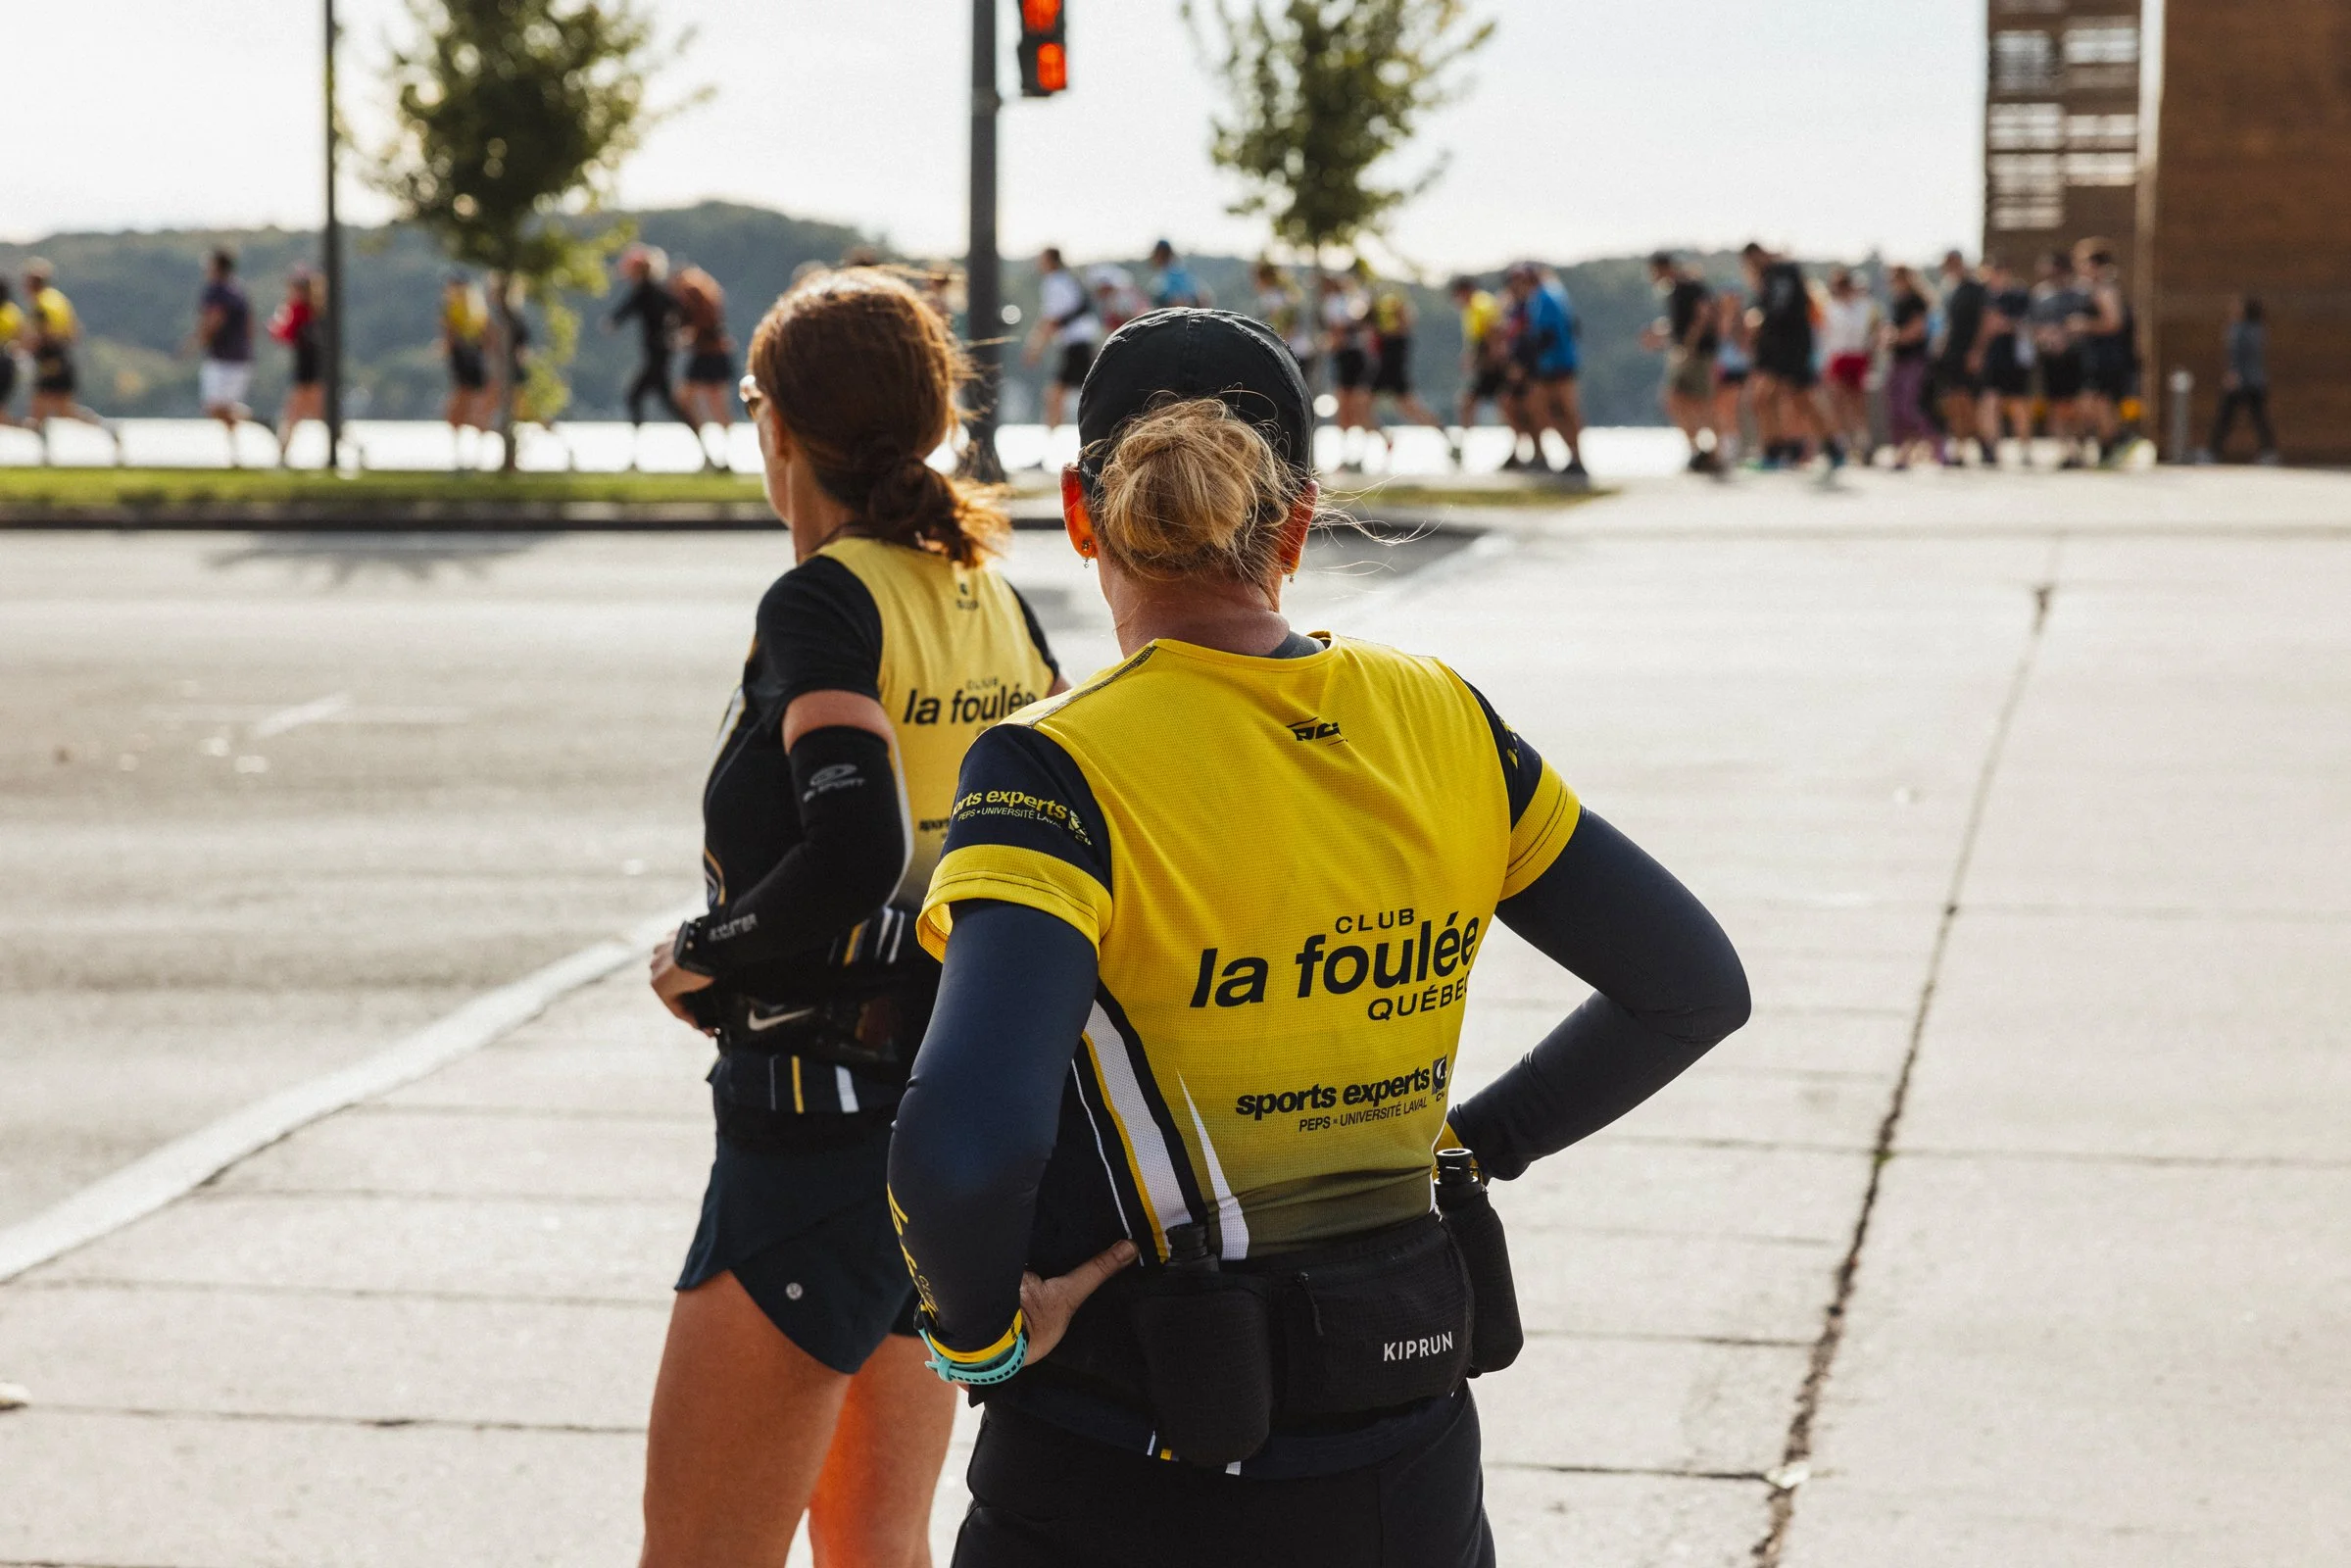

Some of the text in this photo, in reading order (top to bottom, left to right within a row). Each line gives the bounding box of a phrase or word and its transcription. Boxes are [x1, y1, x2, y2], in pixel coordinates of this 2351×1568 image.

[903, 689, 941, 724] la
[952, 790, 1067, 820] orts experts
[957, 808, 976, 821] PEPS
[981, 807, 1035, 819] UNIVERSITÉ
[1335, 907, 1415, 934] CLUB
[1189, 910, 1480, 1008] la foulée
[1235, 1066, 1431, 1121] sports experts
[1298, 1115, 1331, 1133] PEPS
[1340, 1102, 1402, 1128] UNIVERSITÉ
[1403, 1096, 1427, 1117] LAVAL
[1383, 1331, 1453, 1362] KIPRUN
